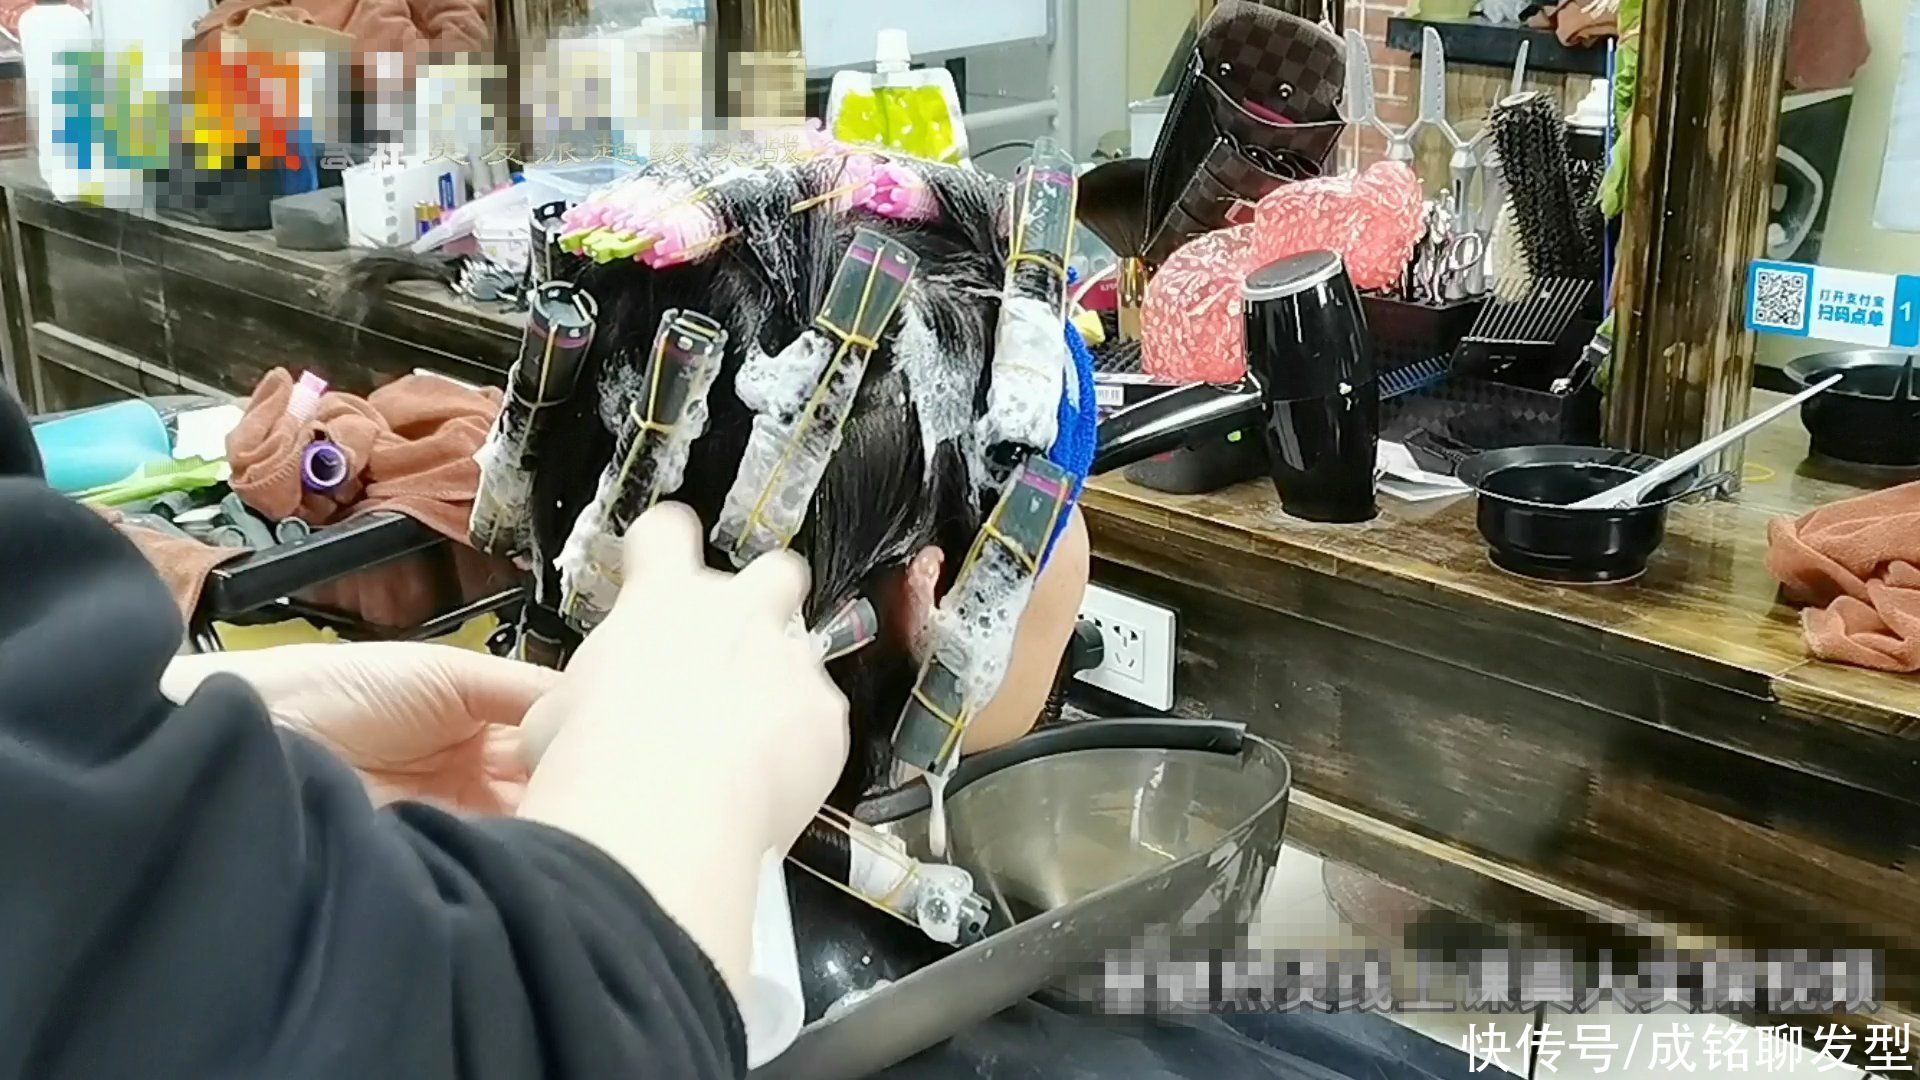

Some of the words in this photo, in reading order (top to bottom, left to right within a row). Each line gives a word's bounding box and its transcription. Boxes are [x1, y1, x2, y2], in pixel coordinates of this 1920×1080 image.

[1820, 289, 1884, 306] 打开支付宝
[1818, 304, 1884, 326] 扫码点单
[1899, 301, 1912, 322] 1
